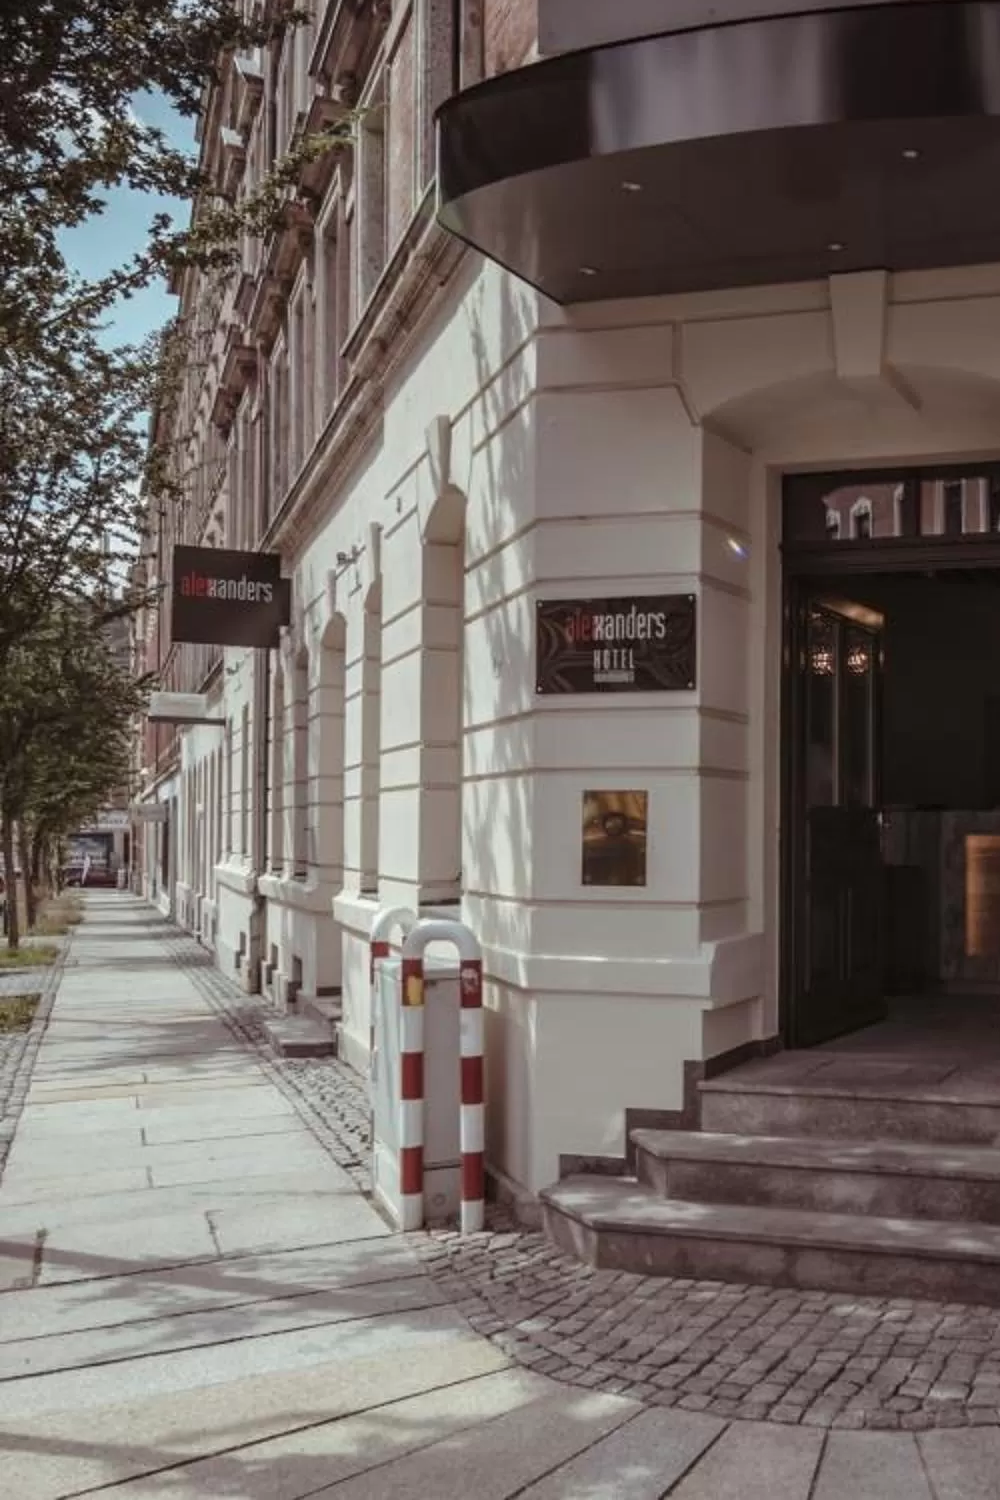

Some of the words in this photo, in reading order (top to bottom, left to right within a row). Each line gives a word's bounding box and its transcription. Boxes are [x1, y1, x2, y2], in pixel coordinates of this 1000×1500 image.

[181, 570, 273, 603] alexanders
[566, 604, 666, 641] alexanders
[593, 648, 635, 669] HOTEL
